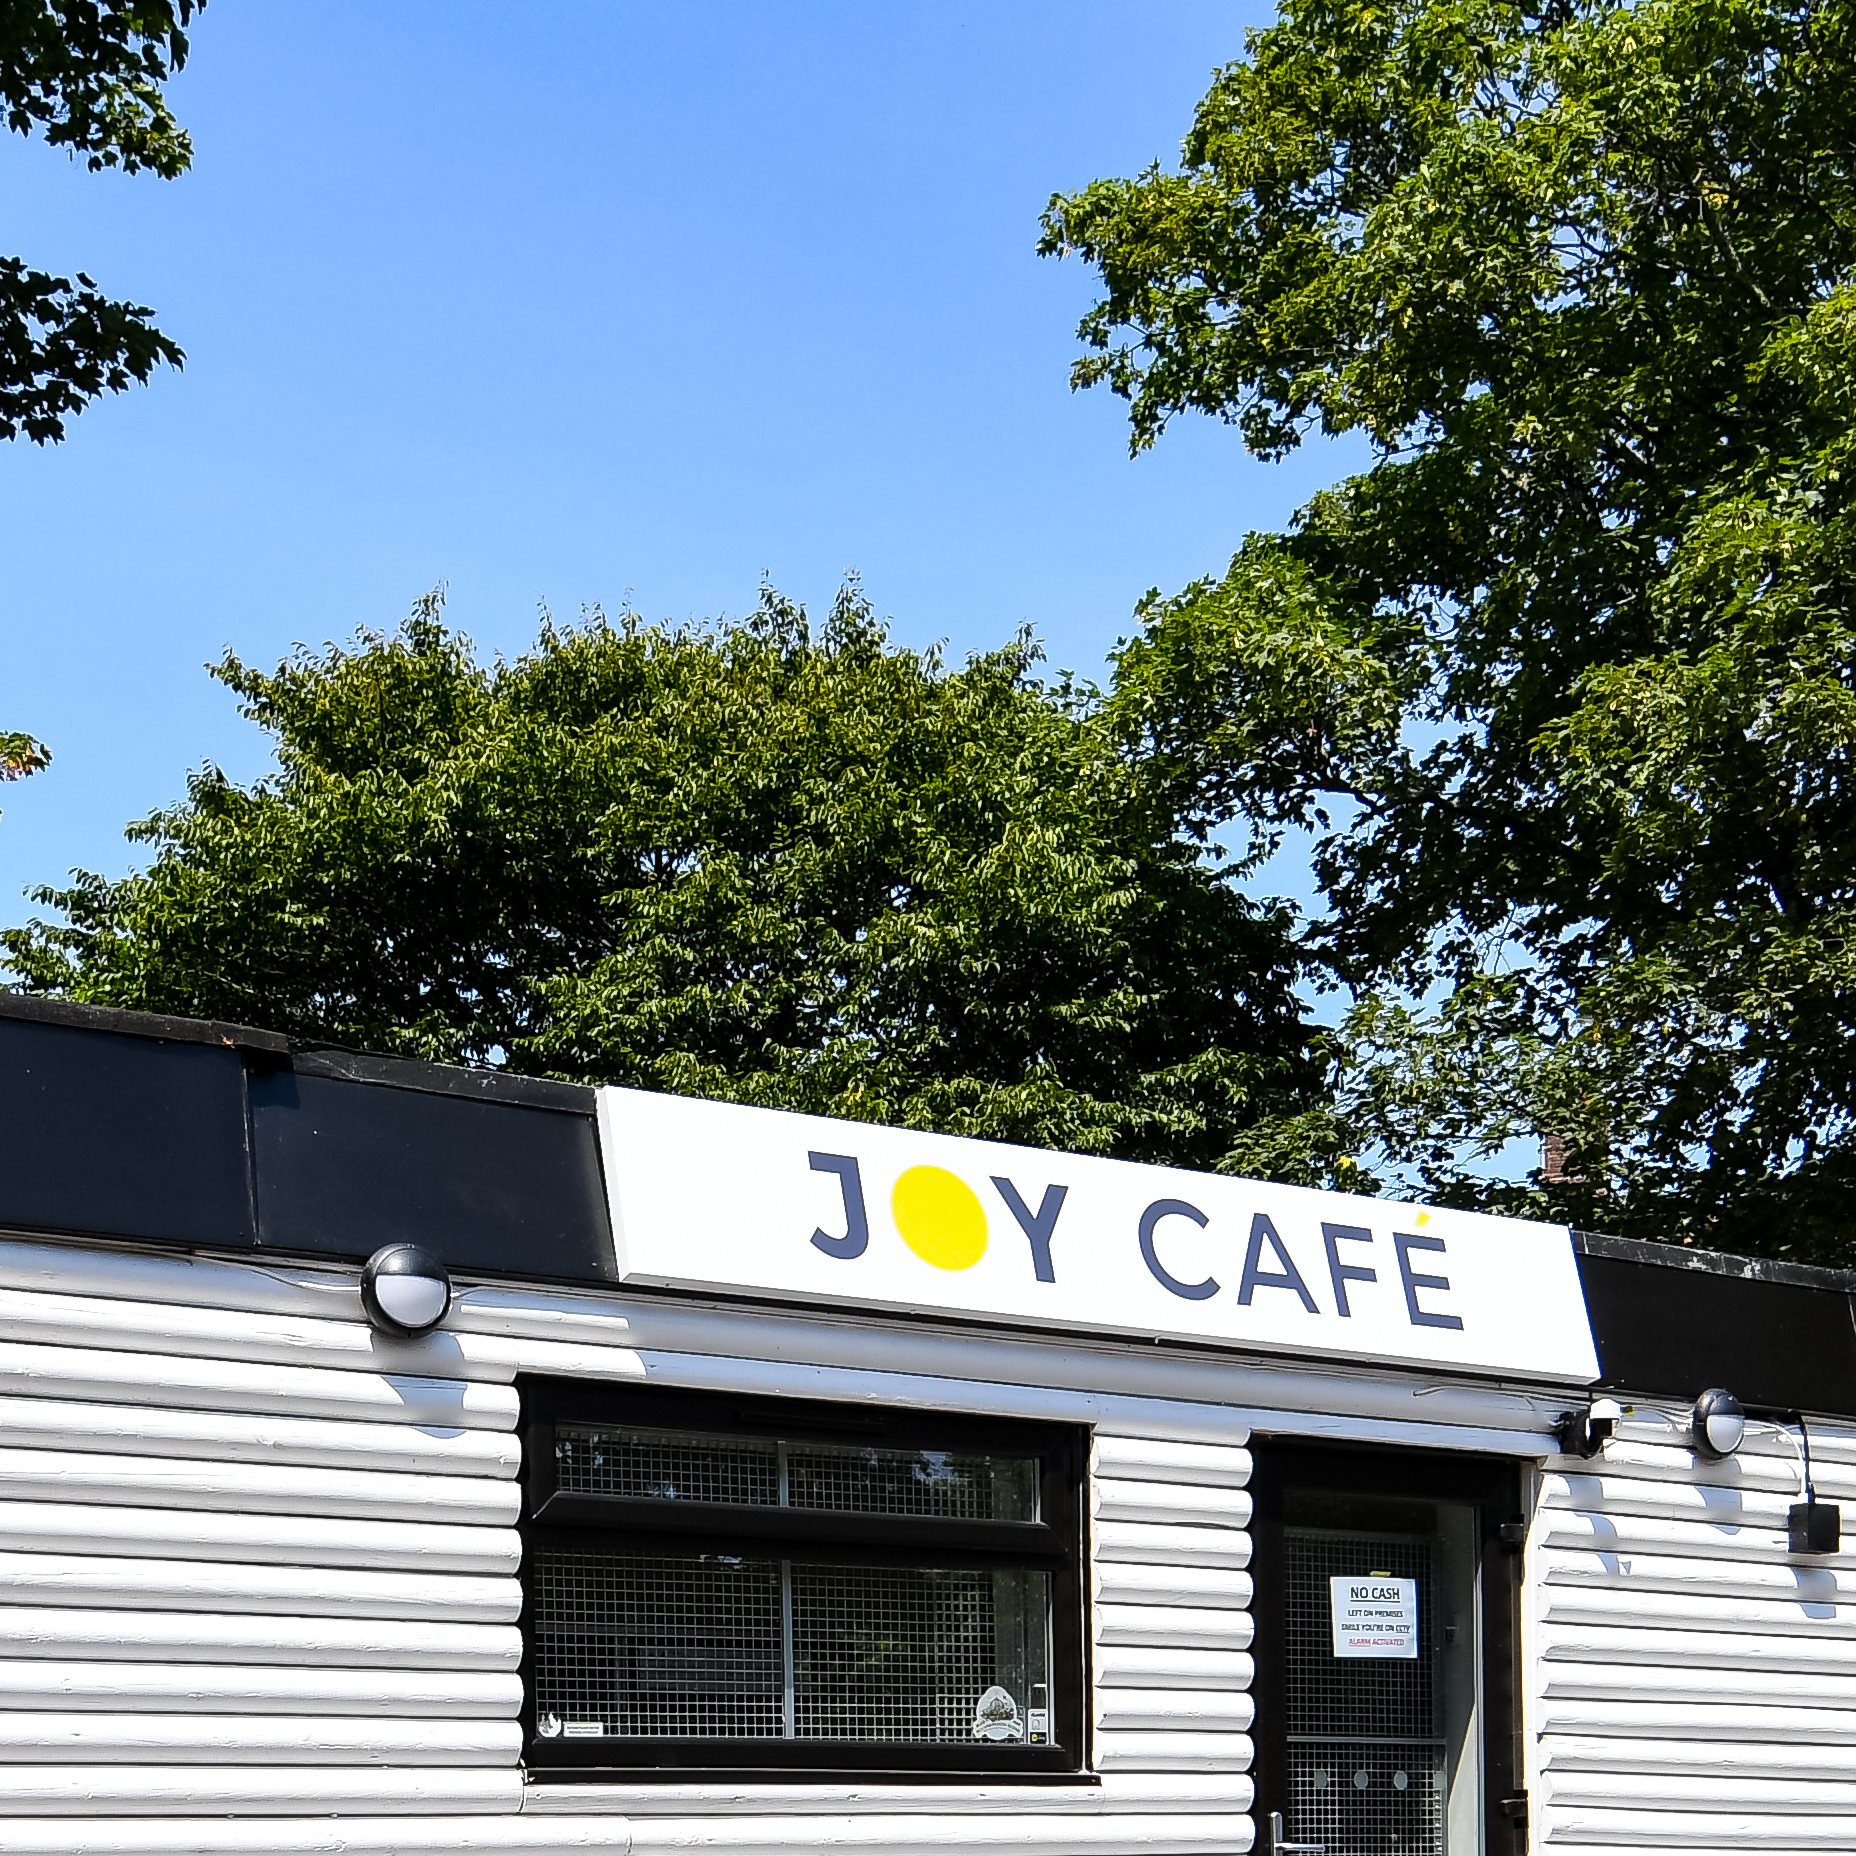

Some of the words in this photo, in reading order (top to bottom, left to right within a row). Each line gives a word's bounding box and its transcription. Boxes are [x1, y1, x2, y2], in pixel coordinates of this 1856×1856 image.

[807, 1151, 1069, 1284] JOY
[1350, 1586, 1369, 1599] NO
[1371, 1587, 1401, 1600] CASH
[1347, 1609, 1362, 1617] LEFT
